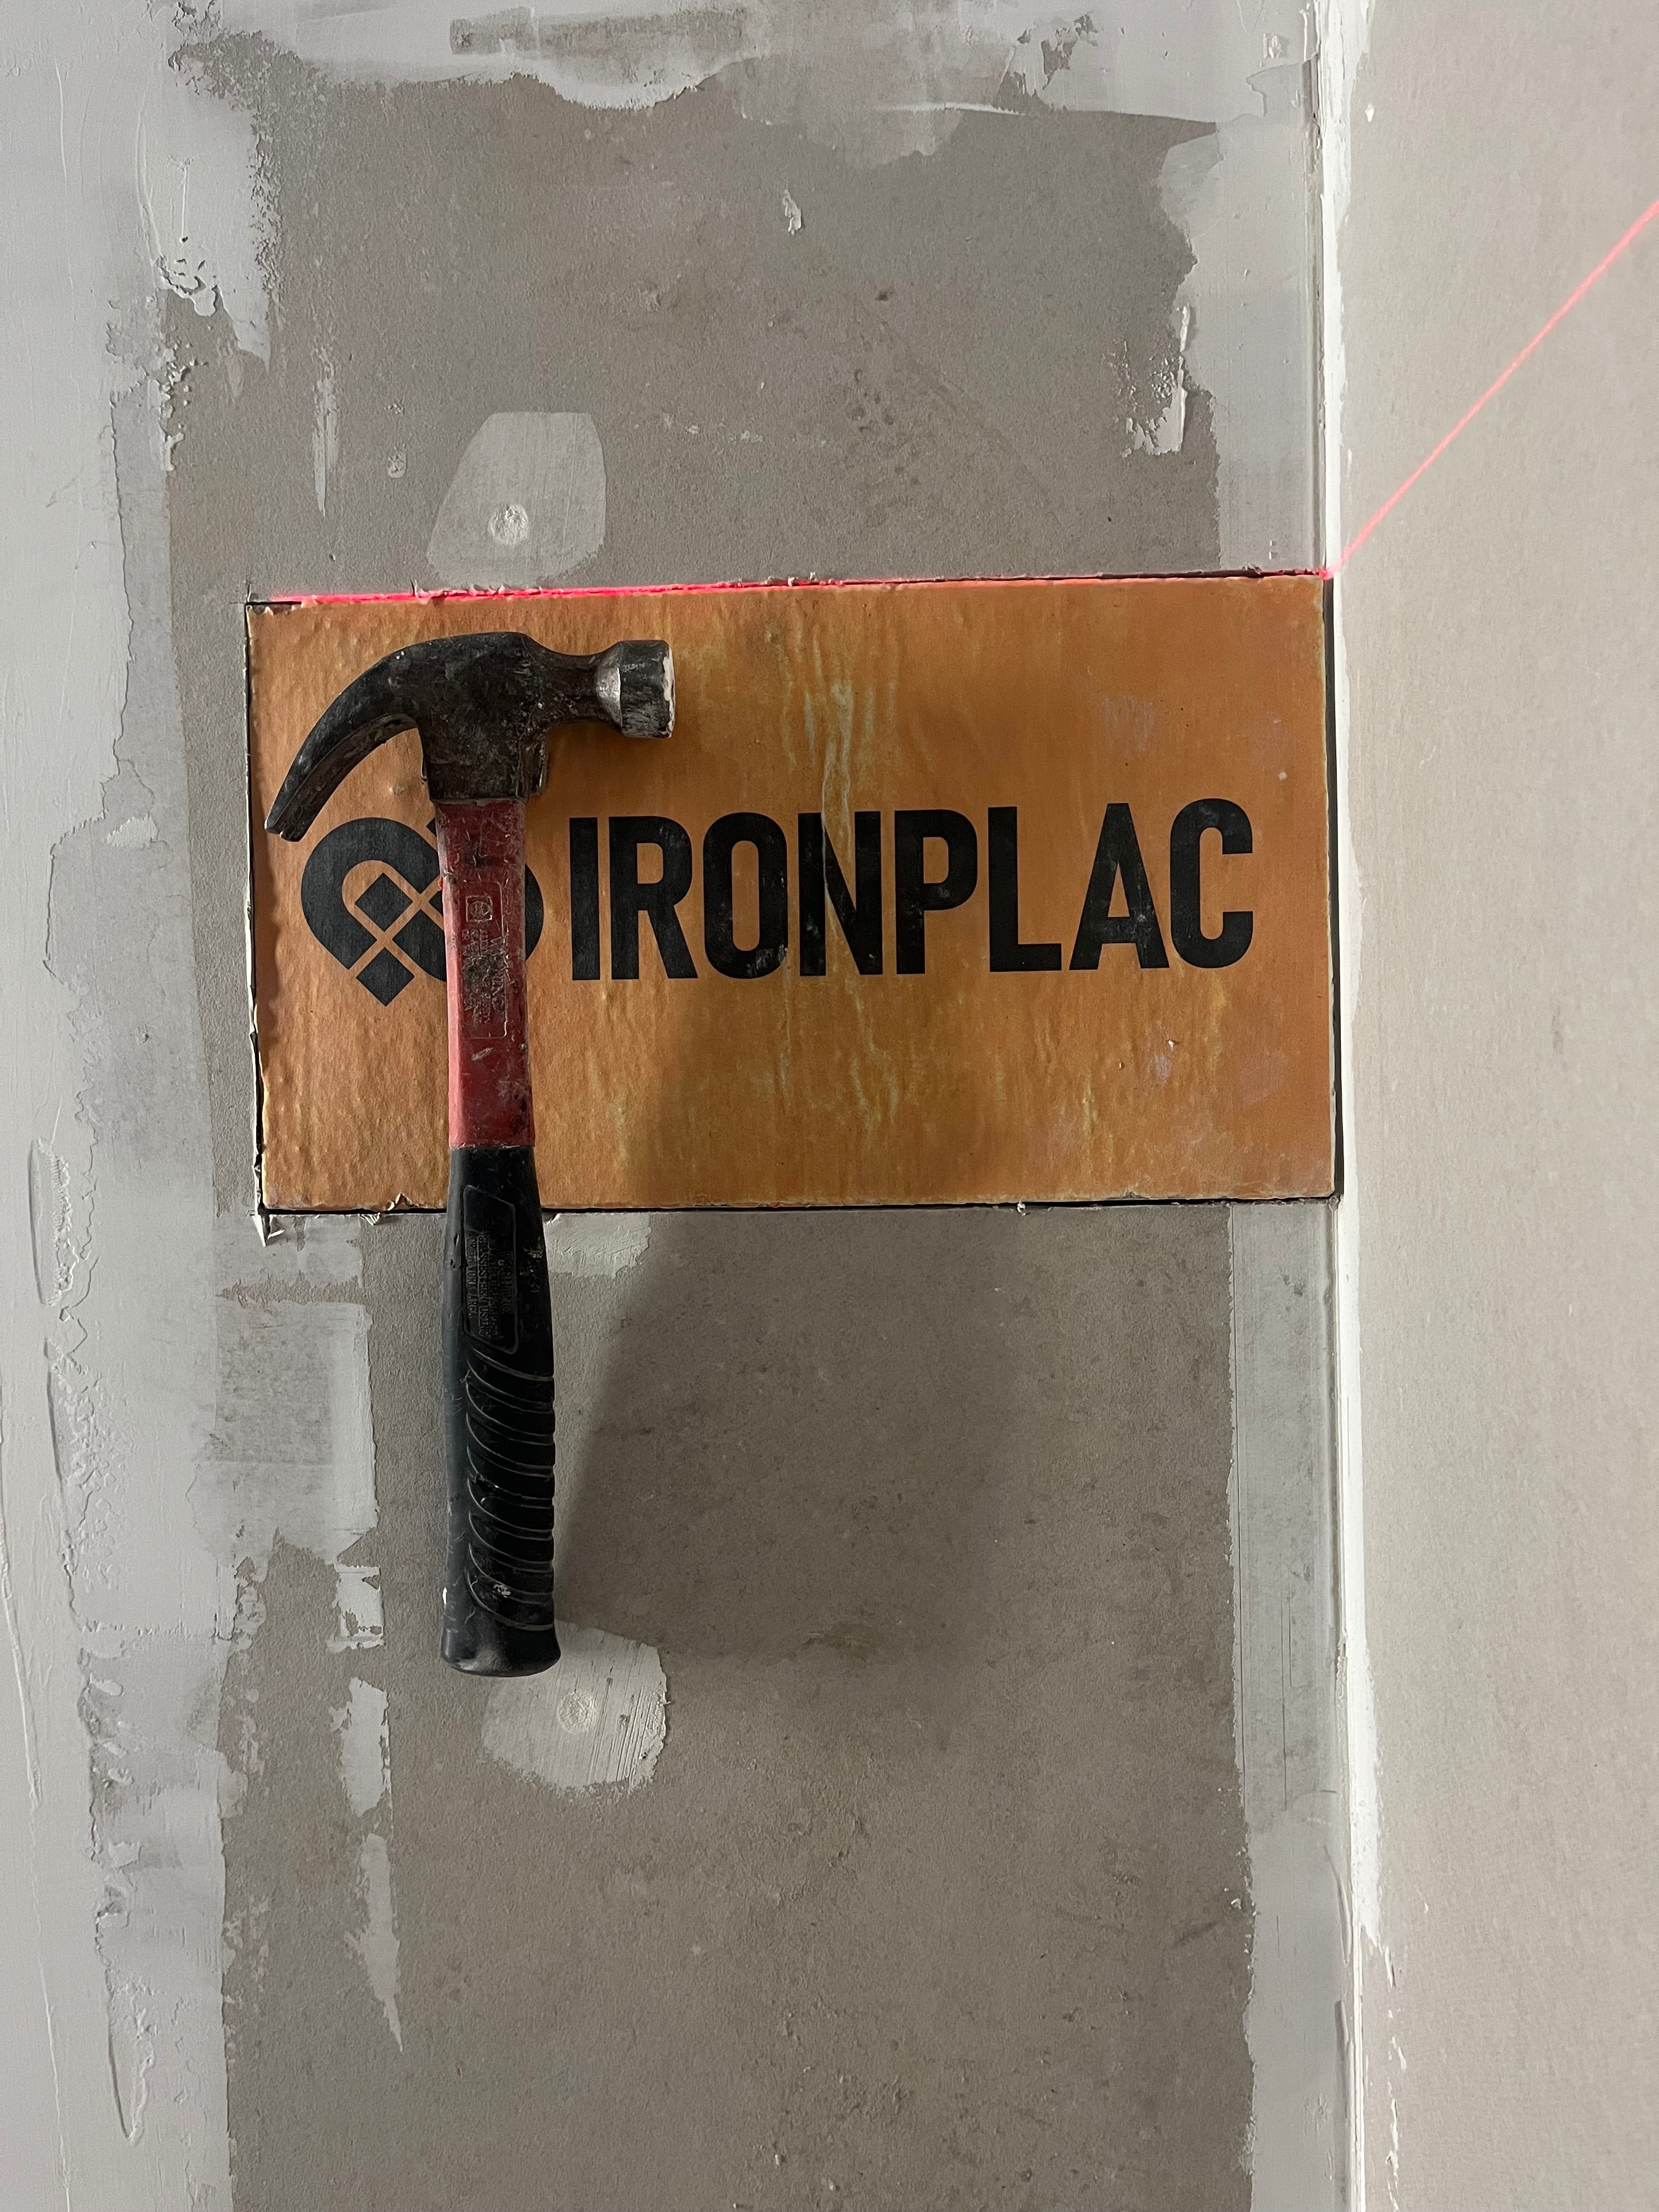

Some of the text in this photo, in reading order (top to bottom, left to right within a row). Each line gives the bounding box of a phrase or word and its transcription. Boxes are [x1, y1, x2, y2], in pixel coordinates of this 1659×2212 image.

[569, 798, 1253, 980] IRONPLAC
[500, 1252, 513, 1313] WARNING
[478, 1306, 490, 1338] USING
